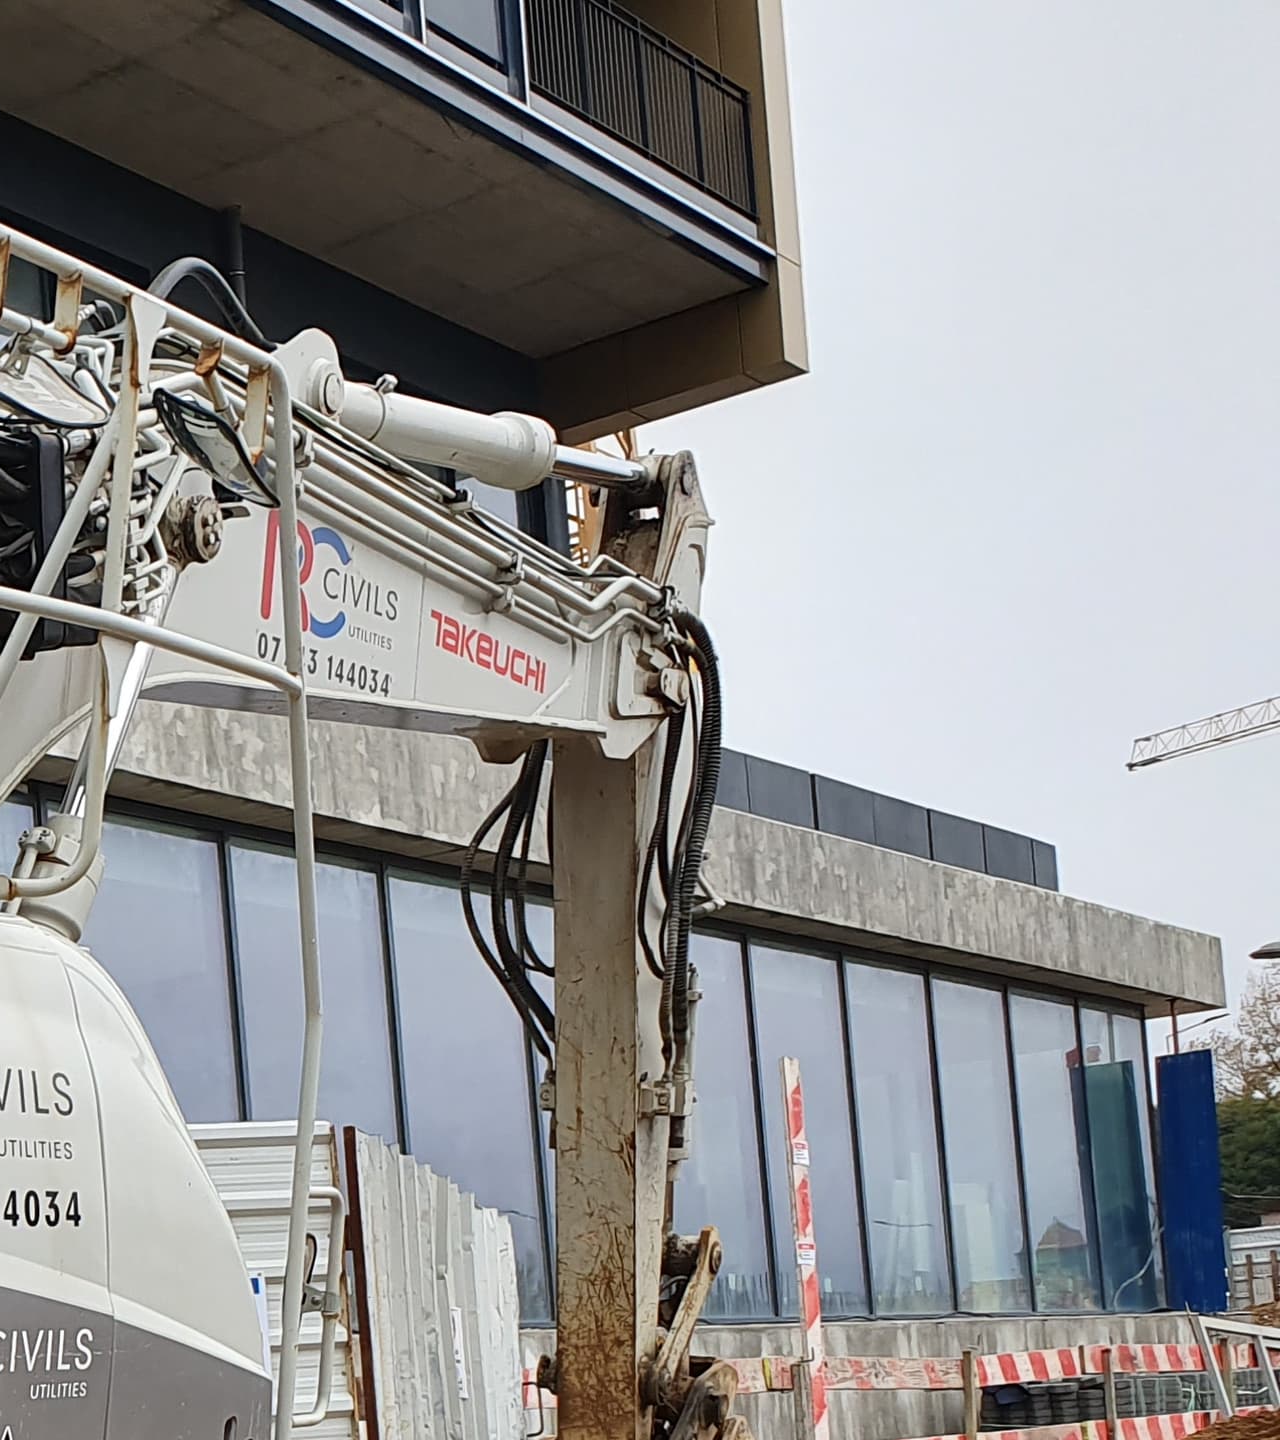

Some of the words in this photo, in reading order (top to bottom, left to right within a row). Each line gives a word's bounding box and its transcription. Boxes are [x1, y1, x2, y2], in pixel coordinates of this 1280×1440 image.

[323, 568, 399, 621] CIVILS
[348, 625, 393, 650] UTILITIES
[258, 633, 318, 674] 073
[327, 656, 391, 697] 144034
[30, 1381, 88, 1400] UTILITIES
